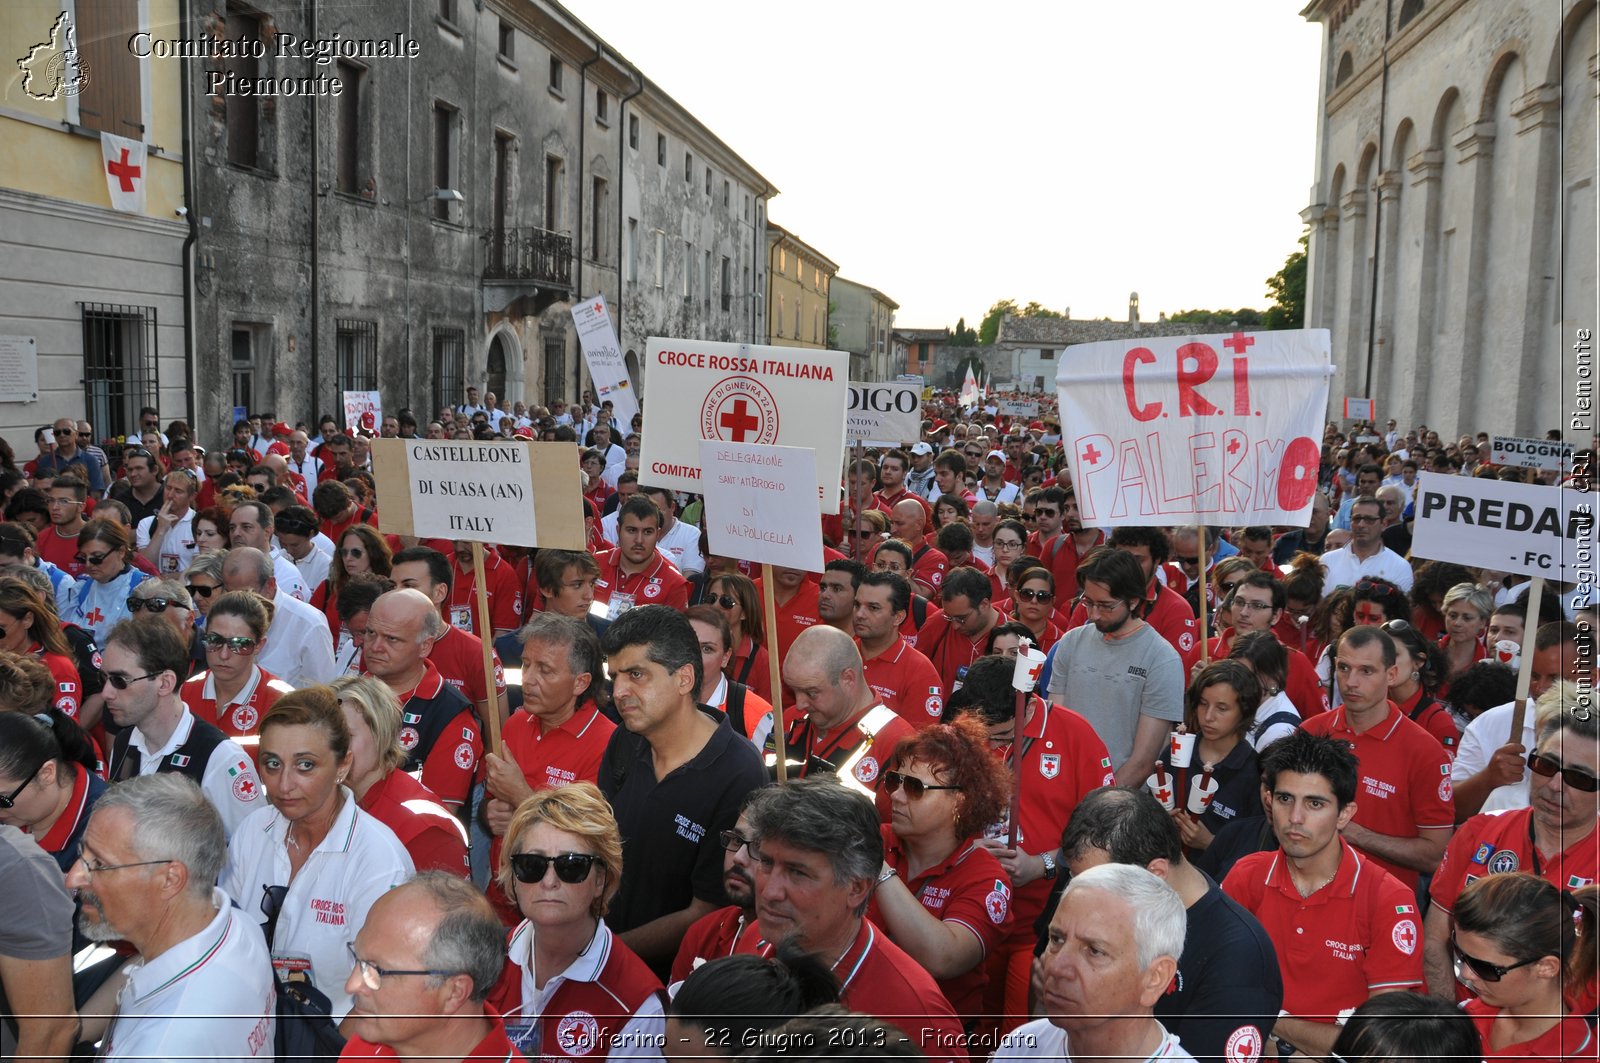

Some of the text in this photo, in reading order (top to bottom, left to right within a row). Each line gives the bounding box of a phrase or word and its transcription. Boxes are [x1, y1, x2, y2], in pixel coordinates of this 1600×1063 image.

[657, 350, 834, 382] CROCE ROSSA ITALIANA
[725, 381, 762, 399] GINEVRA
[760, 396, 770, 408] 22
[413, 445, 522, 464] CASTELLEONE
[1493, 441, 1572, 458] BOLOGNA
[716, 450, 784, 468] DELEGAZIONE
[1075, 429, 1321, 521] PALERMO
[418, 479, 523, 503] DI SUASA (AN)
[742, 507, 754, 517] DI
[1421, 491, 1600, 541] PREDAP
[449, 515, 495, 533] ITALY
[726, 525, 794, 546] VALPOLICELLA
[1523, 551, 1552, 569] FC
[311, 899, 332, 912] CROCE
[315, 911, 345, 926] ITALIANA
[1325, 939, 1348, 951] CROCE
